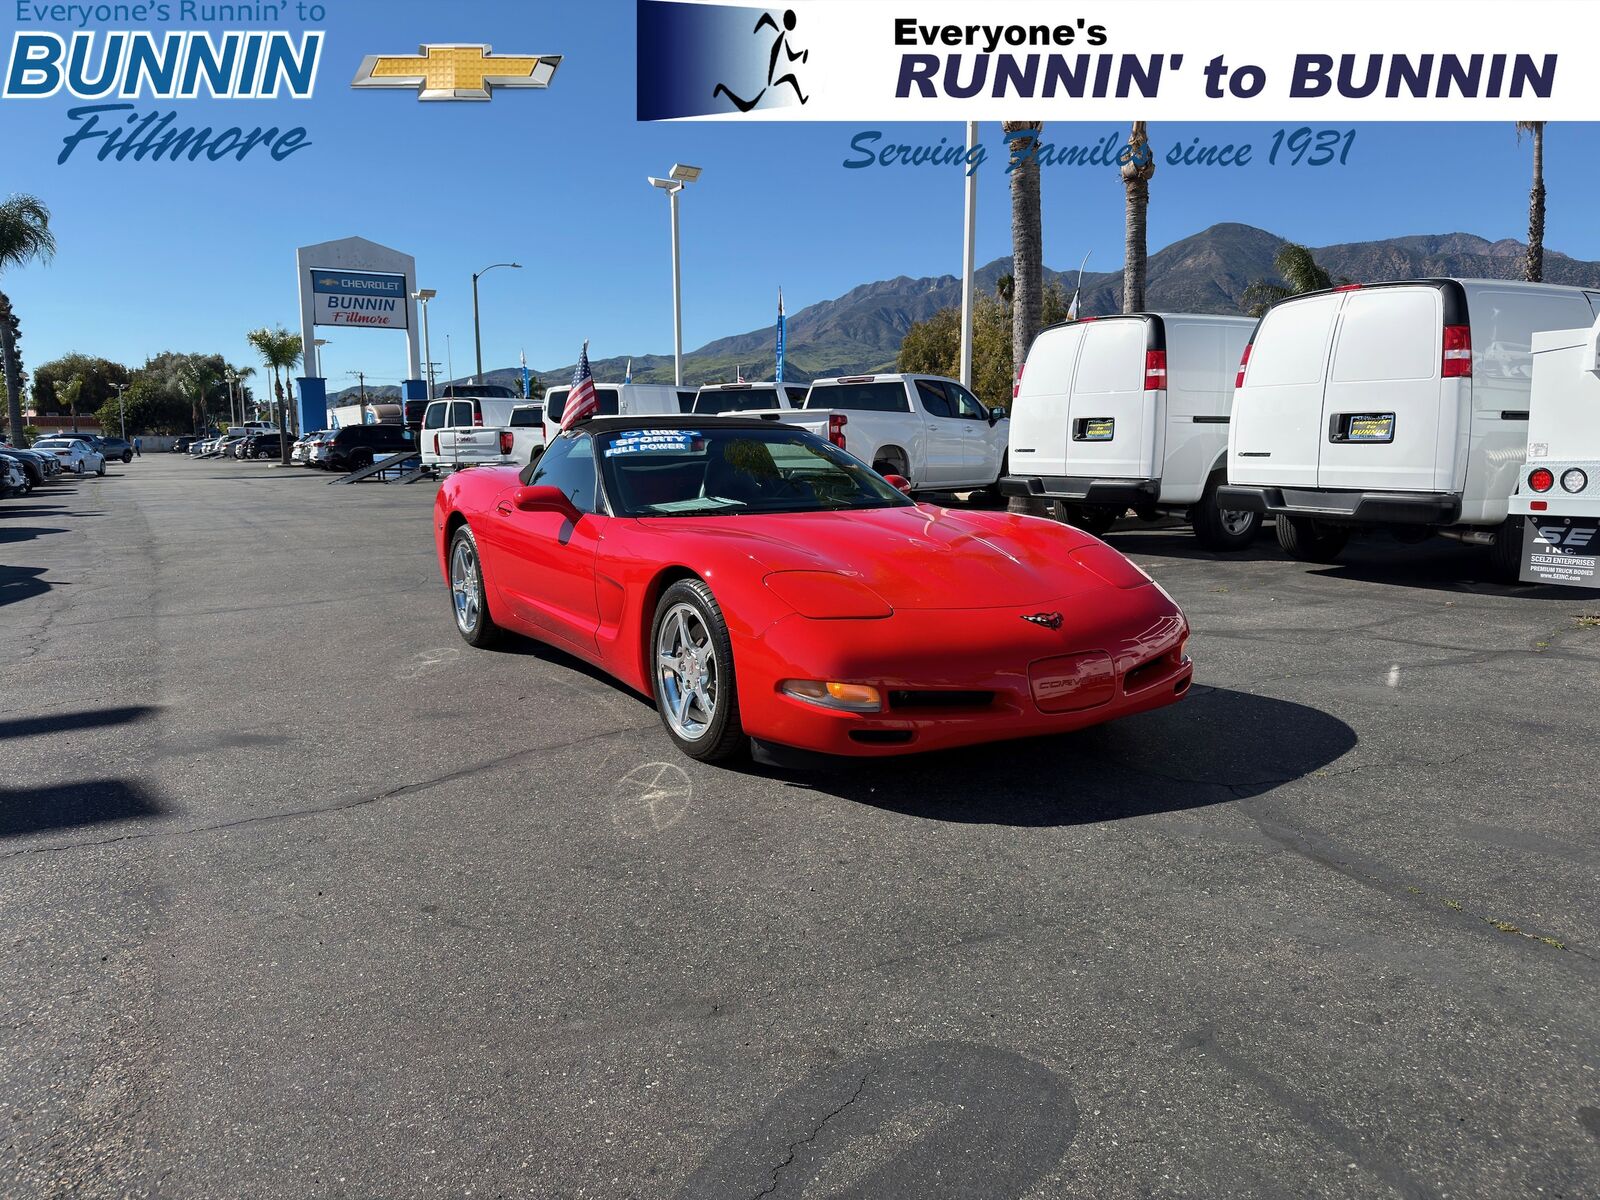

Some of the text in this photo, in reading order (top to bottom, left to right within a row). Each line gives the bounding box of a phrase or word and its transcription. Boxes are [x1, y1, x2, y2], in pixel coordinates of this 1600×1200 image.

[341, 279, 399, 291] CHEVROLET
[327, 295, 395, 311] BUNNIN
[332, 311, 390, 325] Fillmore
[616, 436, 686, 446] SPORTY
[606, 442, 686, 458] FULL POWER
[1532, 526, 1597, 546] SE
[1552, 557, 1596, 566] ENTERPRISES
[1530, 565, 1556, 573] PREMIUM
[1555, 567, 1573, 575] TRUCK
[1540, 573, 1581, 581] www.SEINC.com
